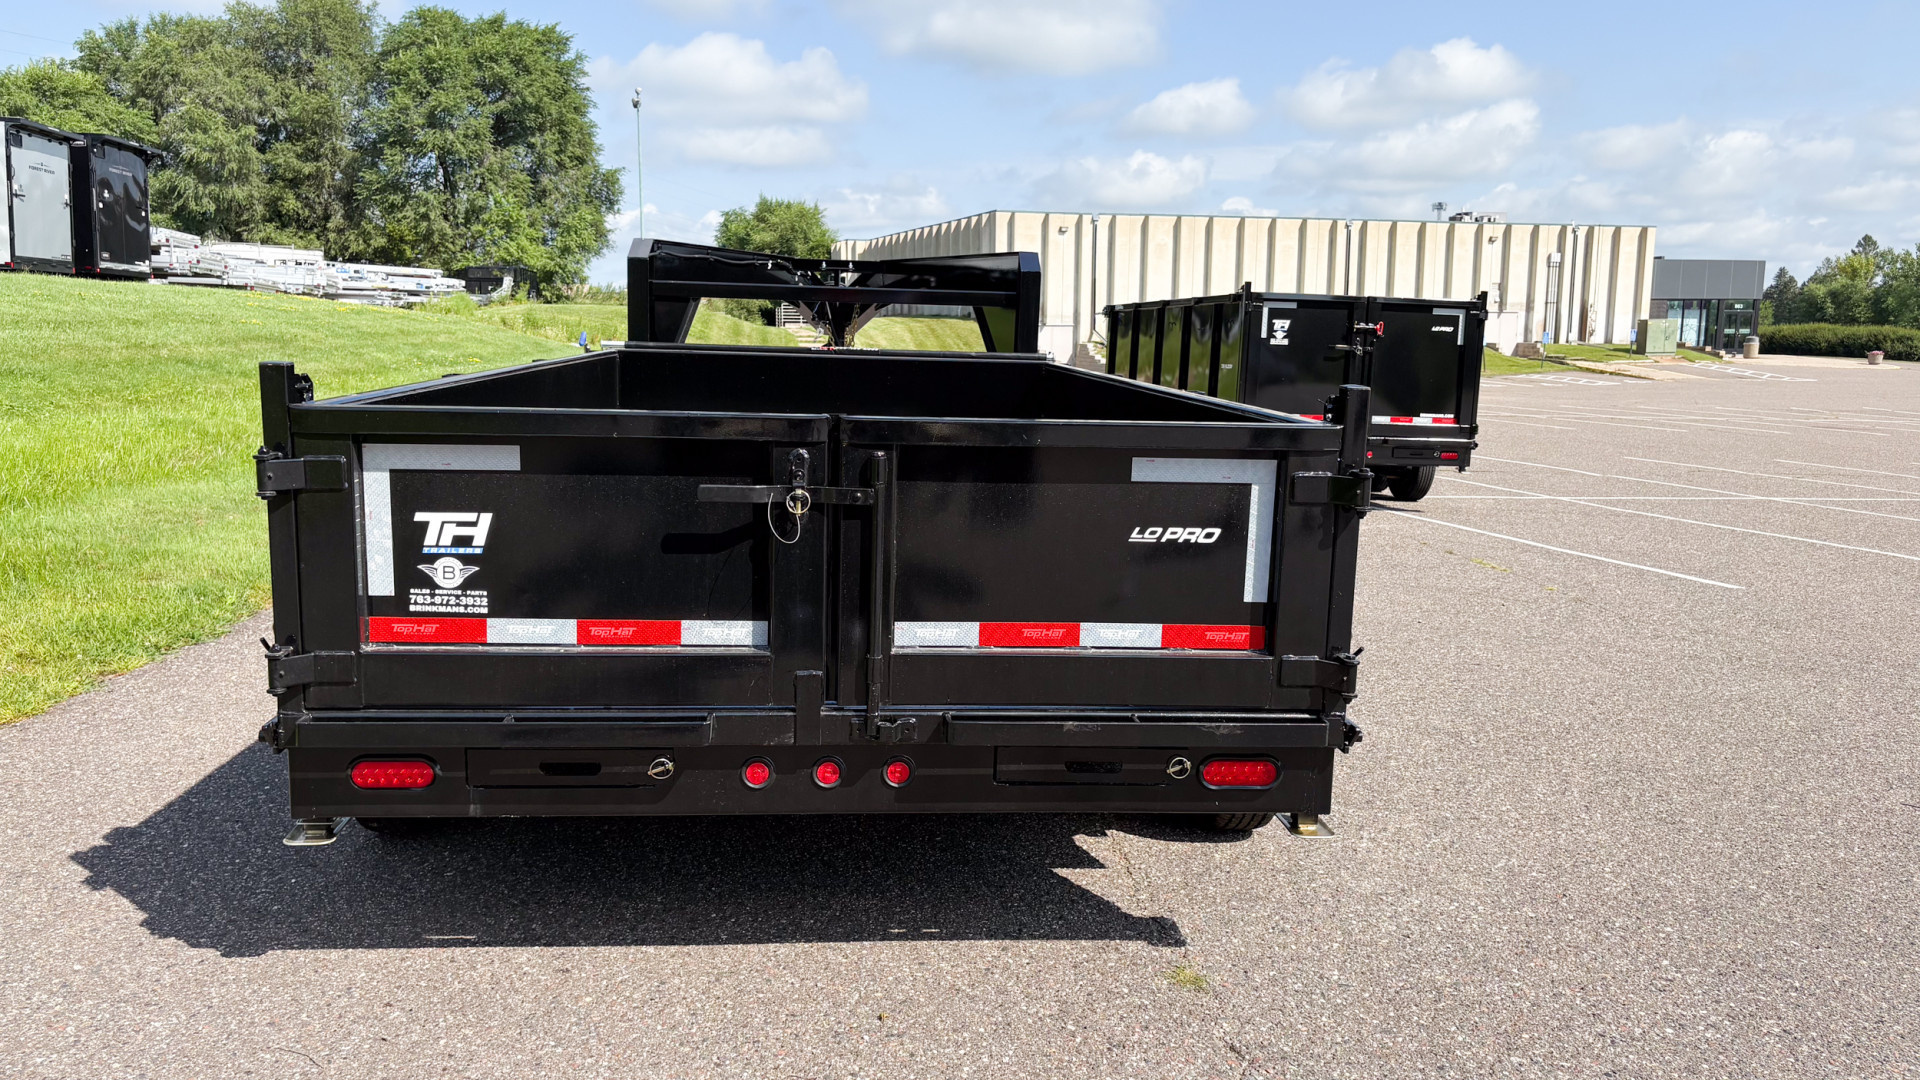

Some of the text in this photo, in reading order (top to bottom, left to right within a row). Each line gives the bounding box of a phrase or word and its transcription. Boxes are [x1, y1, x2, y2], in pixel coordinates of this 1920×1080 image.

[1129, 527, 1222, 543] LO PRO
[409, 594, 488, 606] 763-972-3932
[409, 604, 488, 614] BRINKMANS.COM
